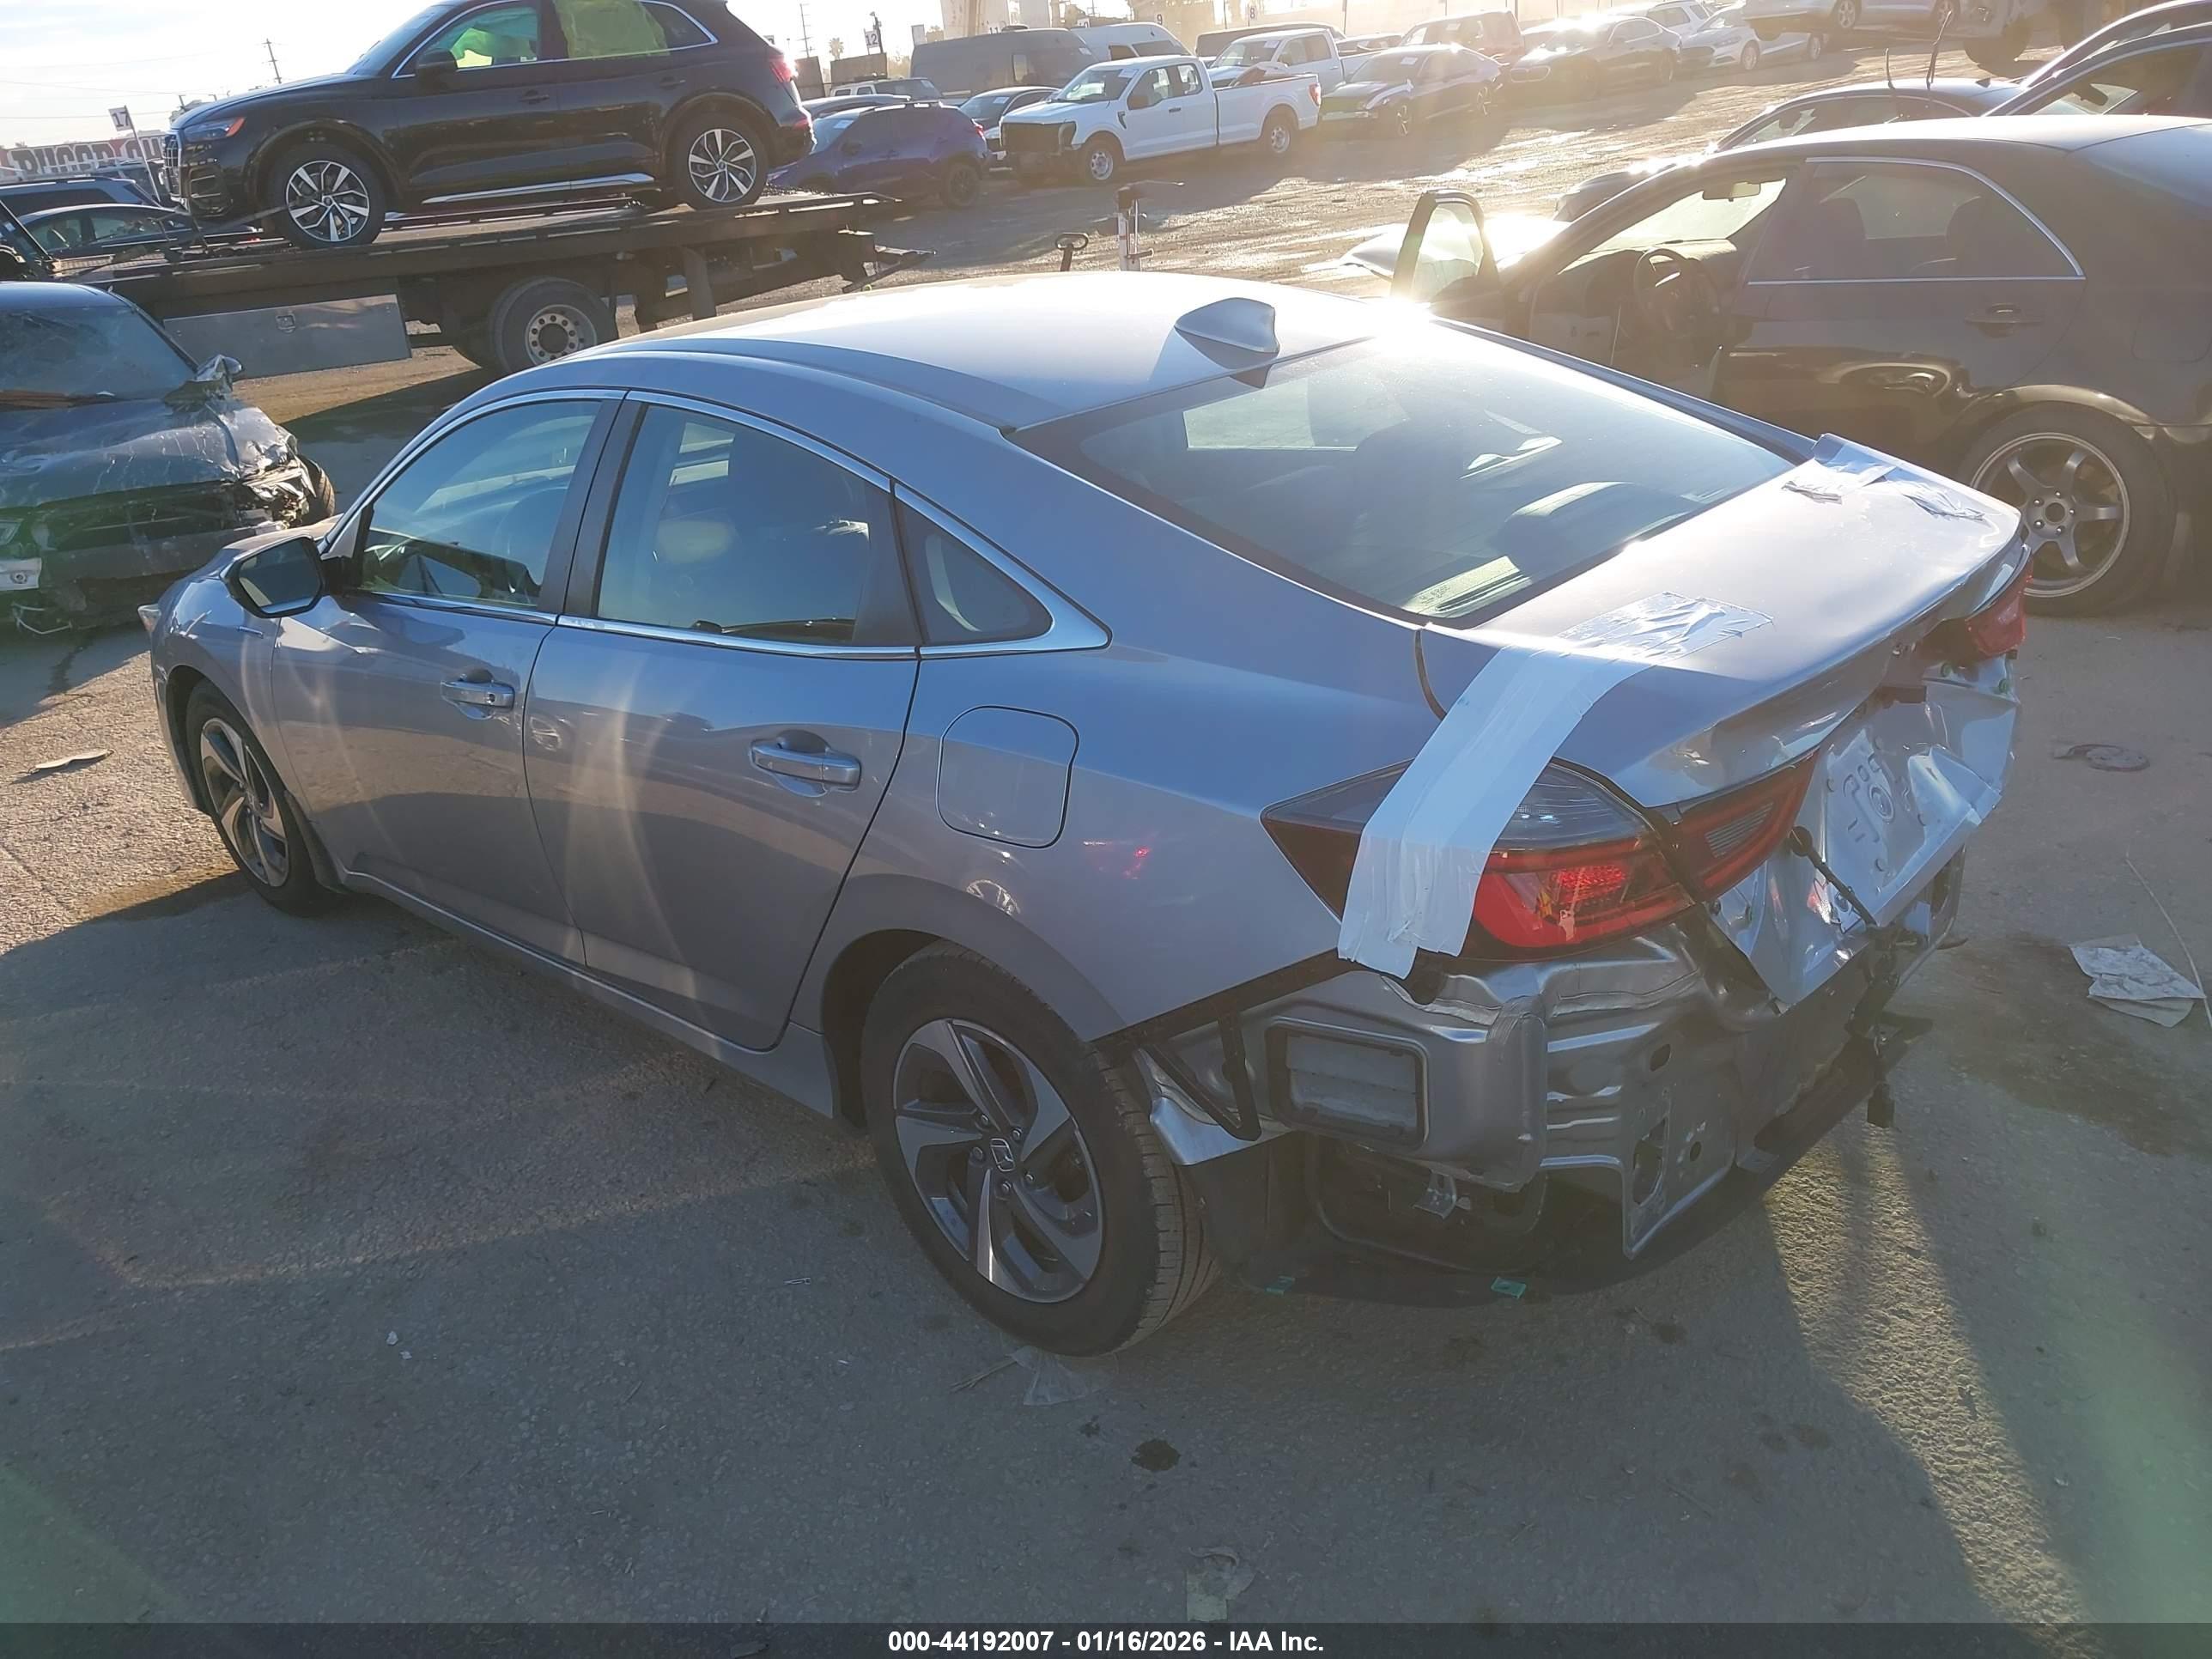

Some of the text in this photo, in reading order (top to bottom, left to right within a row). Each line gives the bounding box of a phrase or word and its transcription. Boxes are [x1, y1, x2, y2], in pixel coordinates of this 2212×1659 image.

[1250, 7, 1255, 19] 8
[1157, 14, 1163, 25] 9
[865, 33, 878, 46] 12
[112, 111, 129, 127] 17
